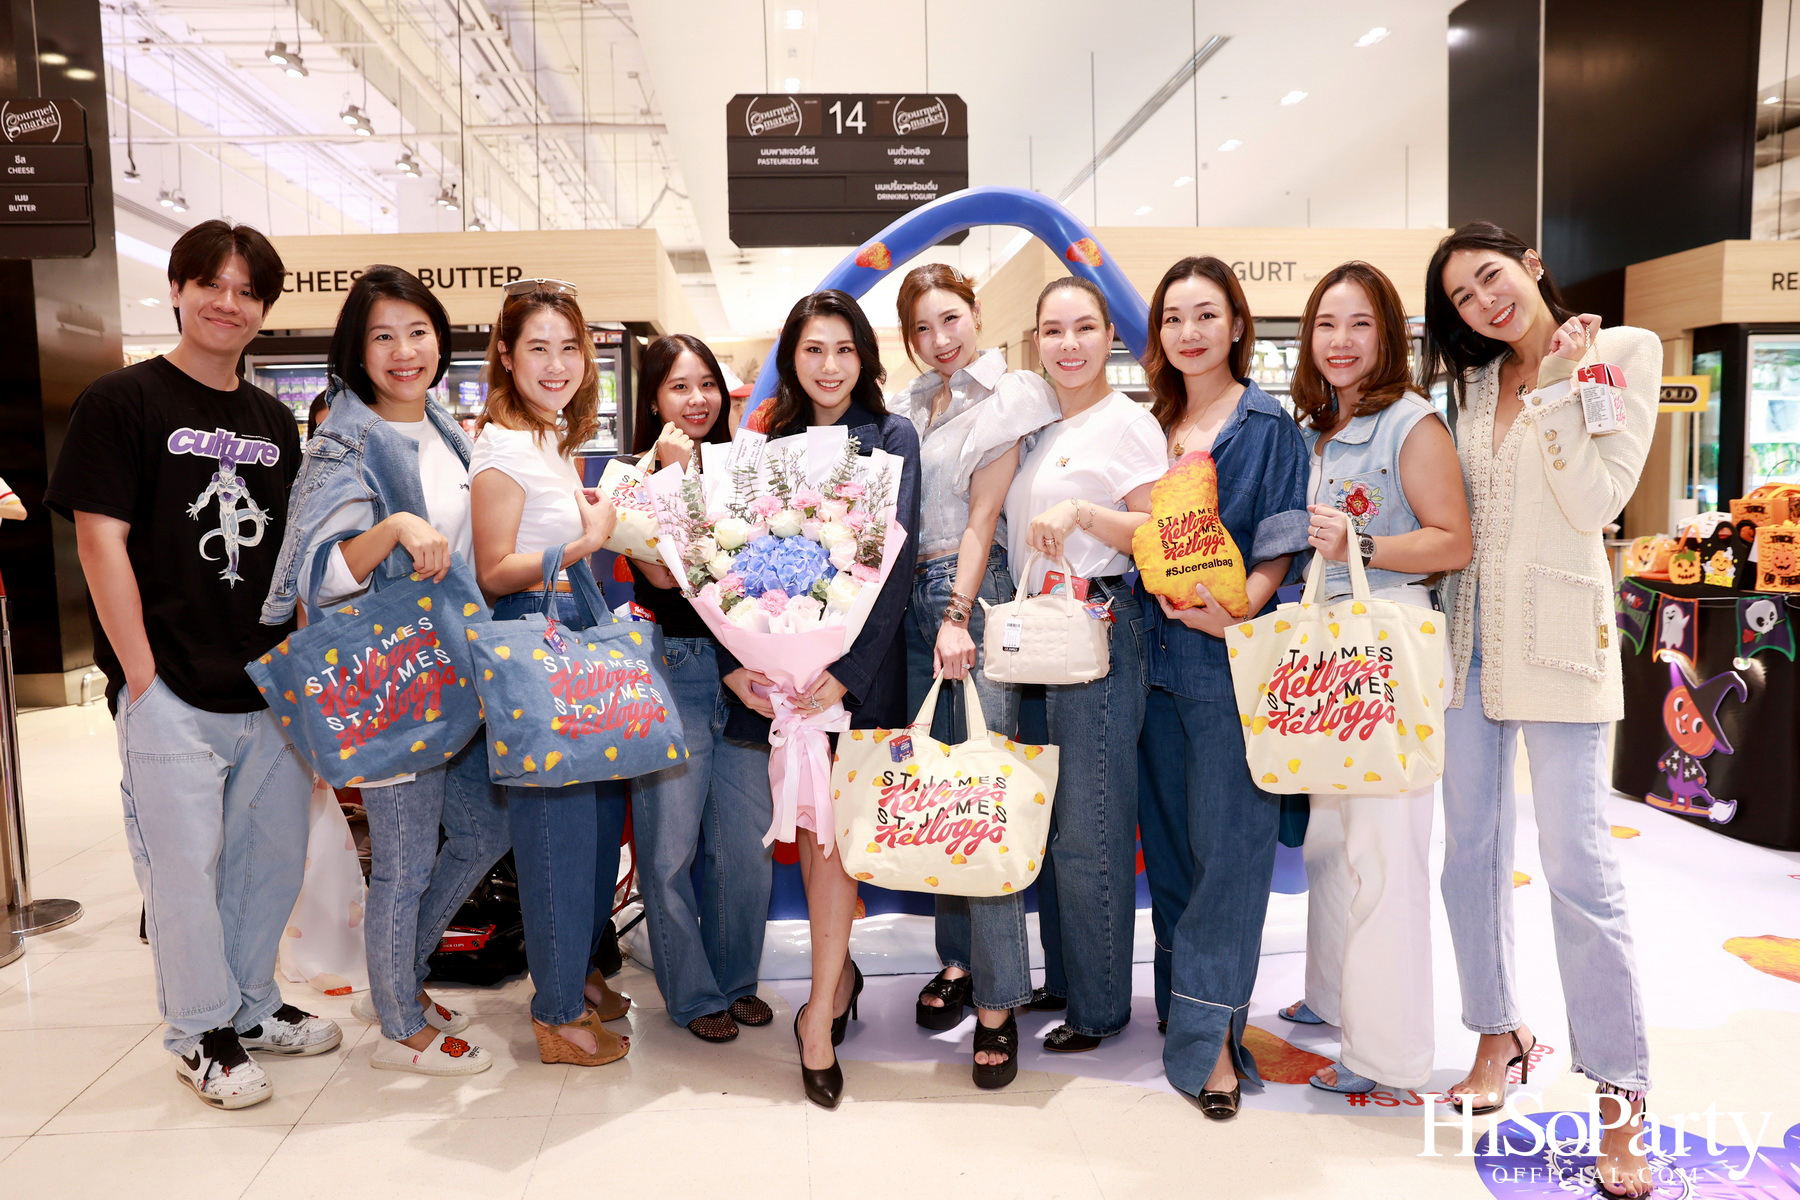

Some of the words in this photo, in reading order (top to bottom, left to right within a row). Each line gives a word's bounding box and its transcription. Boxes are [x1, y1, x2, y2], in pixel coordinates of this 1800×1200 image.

[20, 115, 58, 132] market
[828, 100, 867, 135] 14
[417, 266, 523, 294] BUTTER
[1660, 387, 1695, 401] OLD
[168, 427, 280, 467] culture
[1165, 558, 1234, 578] #SJcerealbag
